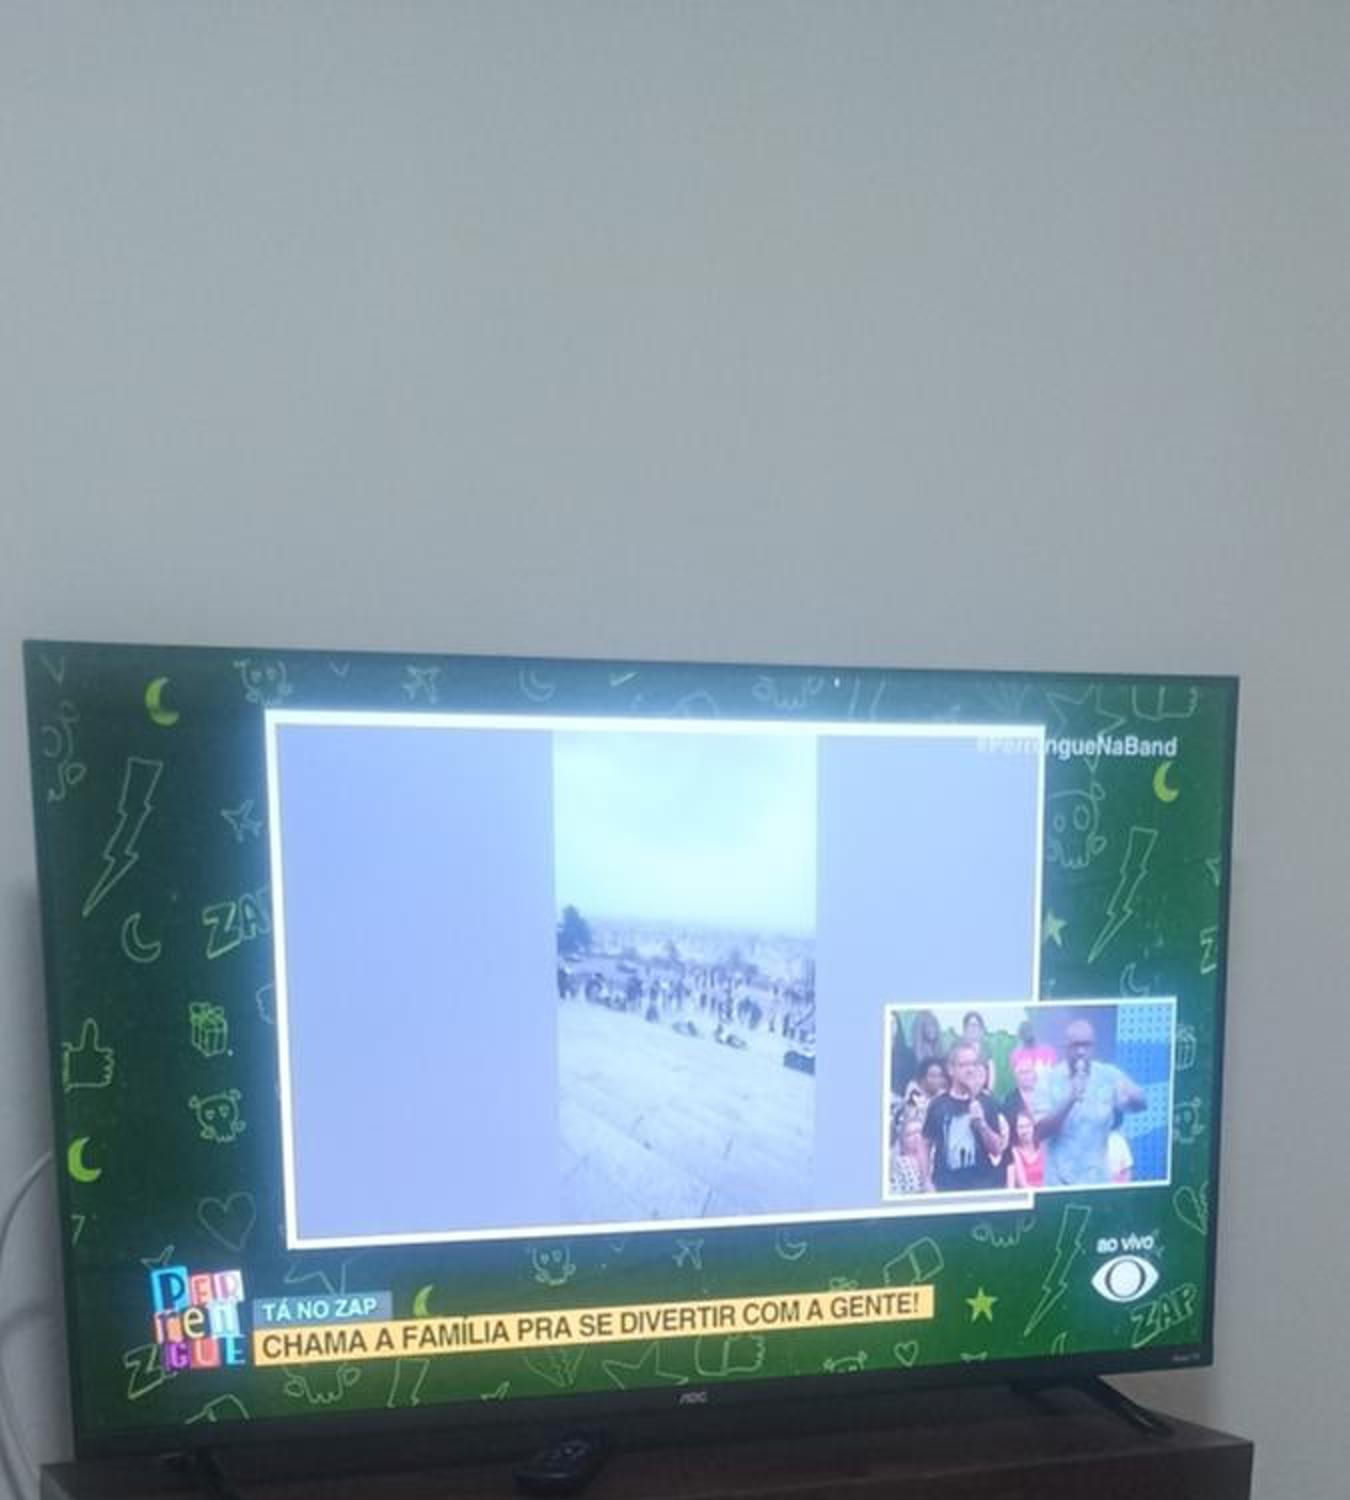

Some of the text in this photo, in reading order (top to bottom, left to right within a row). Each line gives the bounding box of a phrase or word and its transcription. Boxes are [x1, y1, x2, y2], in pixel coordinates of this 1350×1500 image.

[1096, 1233, 1155, 1254] ao vivo
[260, 1296, 378, 1322] TÁ NO ZAP
[261, 1292, 919, 1359] CHAMA A FAMÍLIA PRA SE DIVERTIR COM A GENTE!
[1130, 1283, 1199, 1350] ZAP
